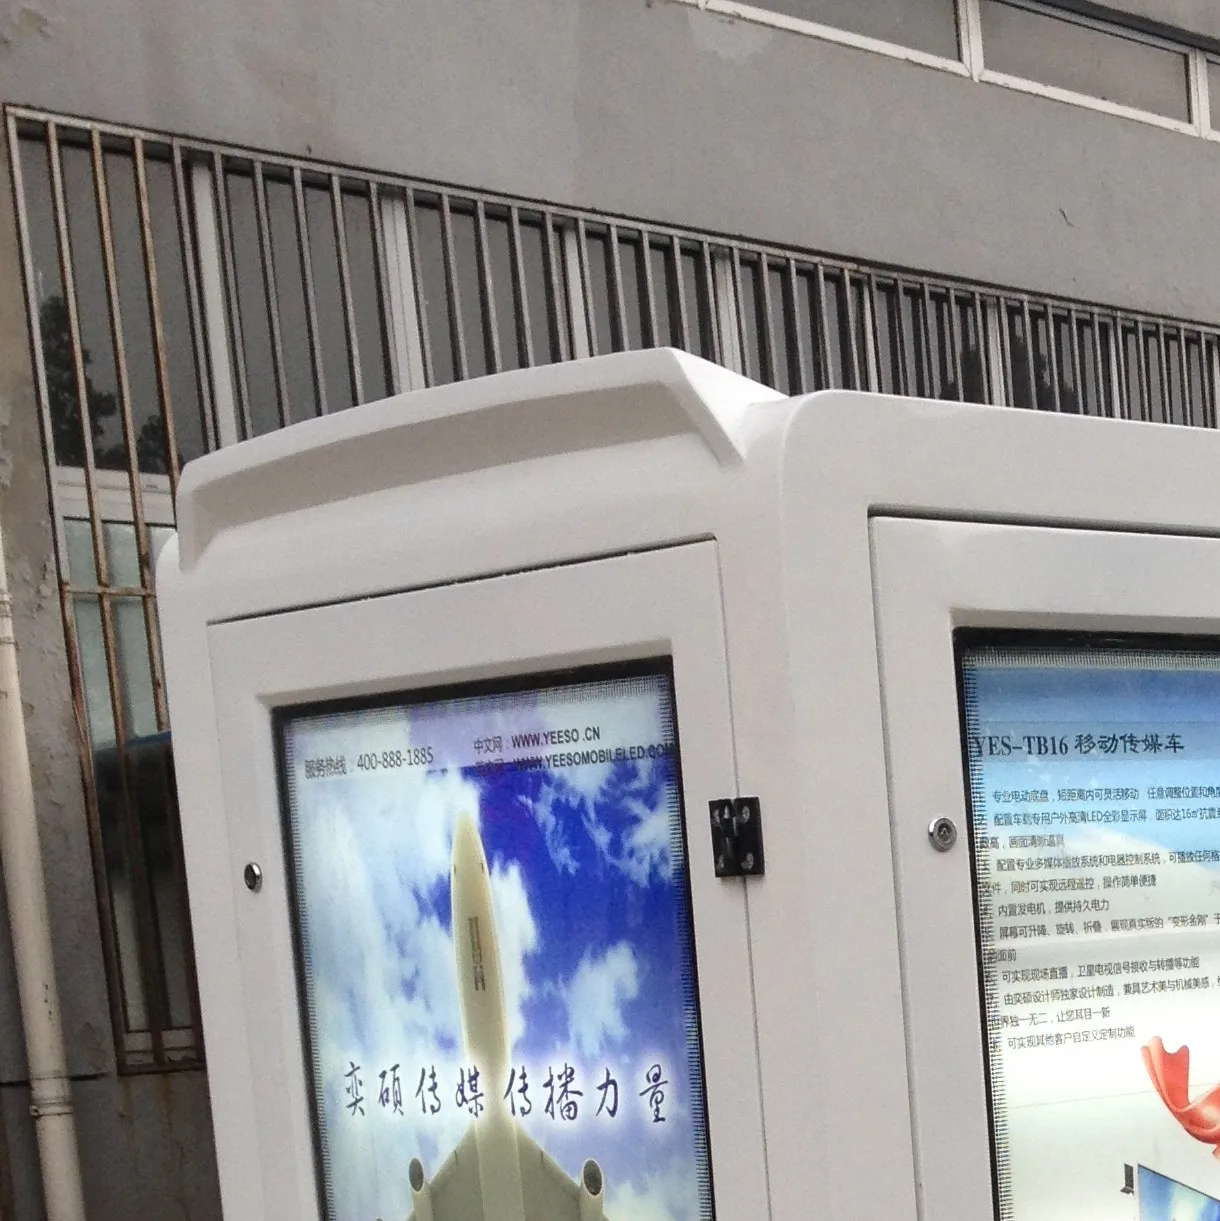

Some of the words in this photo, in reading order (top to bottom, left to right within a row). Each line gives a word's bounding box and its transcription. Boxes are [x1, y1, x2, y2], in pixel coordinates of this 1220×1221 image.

[974, 735, 1069, 757] YES-TB16
[1074, 733, 1185, 755] 移动传媒车
[357, 747, 434, 770] 400-888-1885
